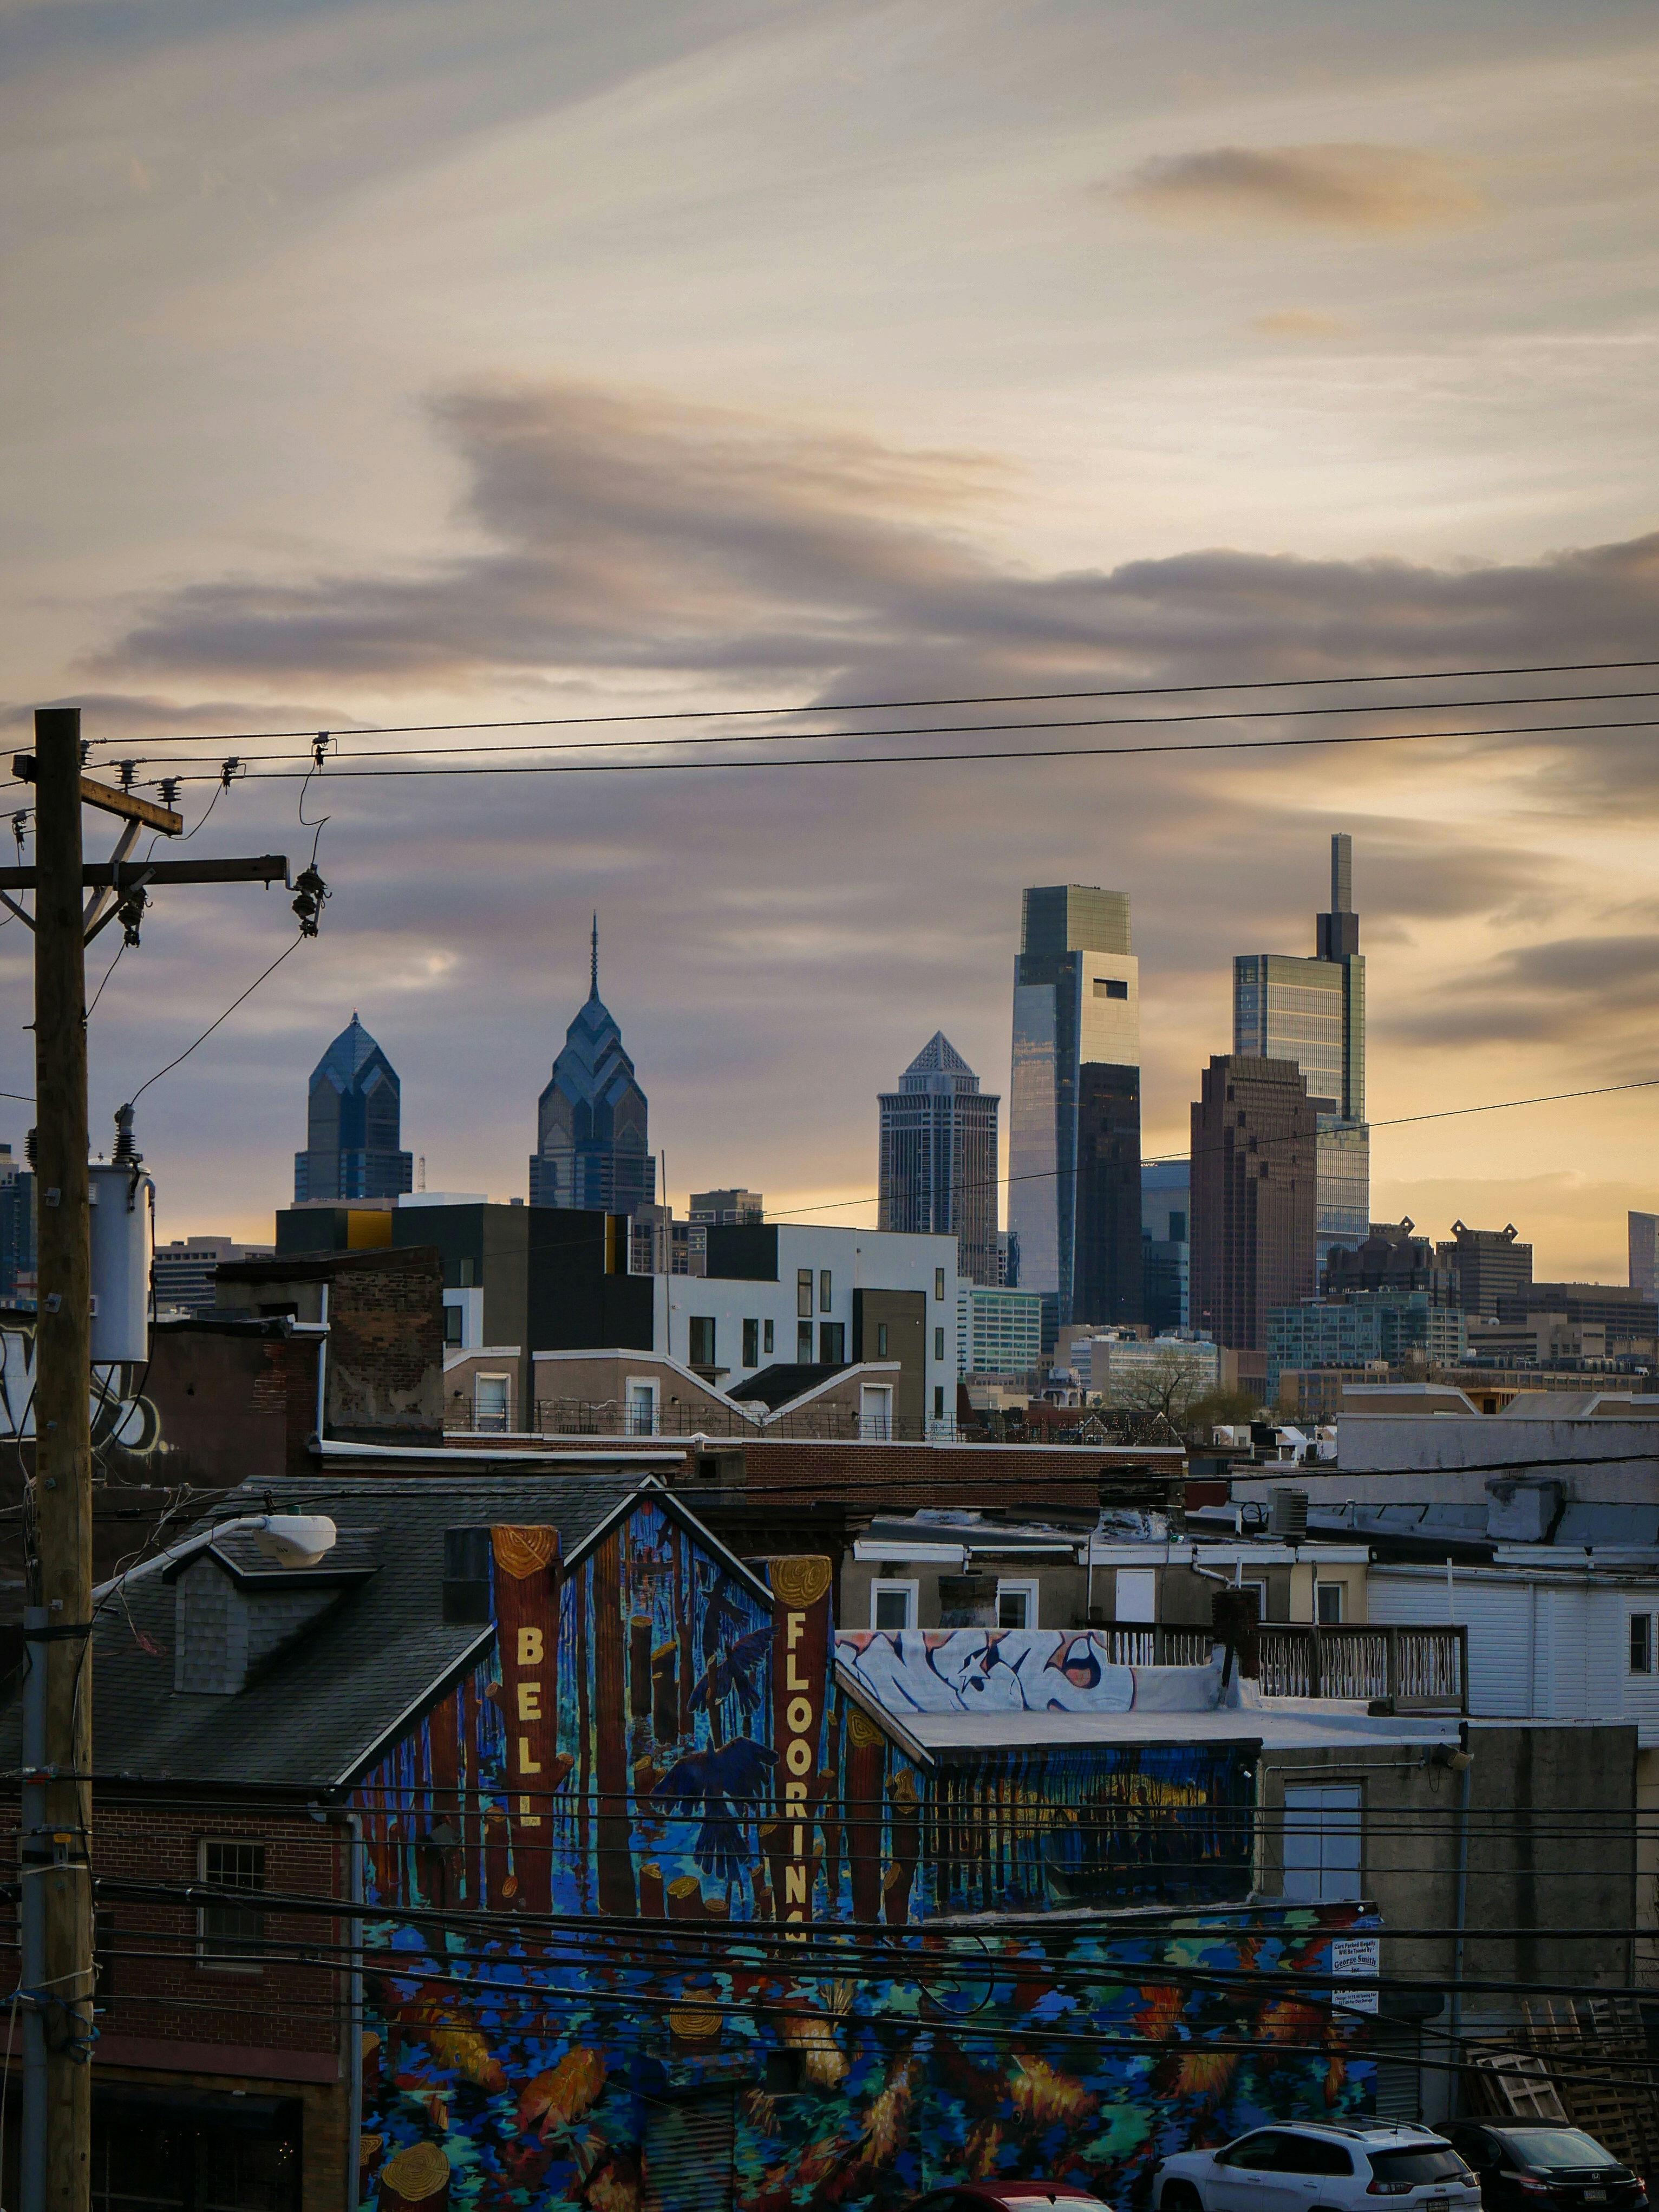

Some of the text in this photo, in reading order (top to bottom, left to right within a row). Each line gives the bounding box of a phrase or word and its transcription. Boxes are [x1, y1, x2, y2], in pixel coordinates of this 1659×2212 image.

[517, 1627, 544, 1826] BELL
[1334, 1955, 1376, 1968] George Smith
